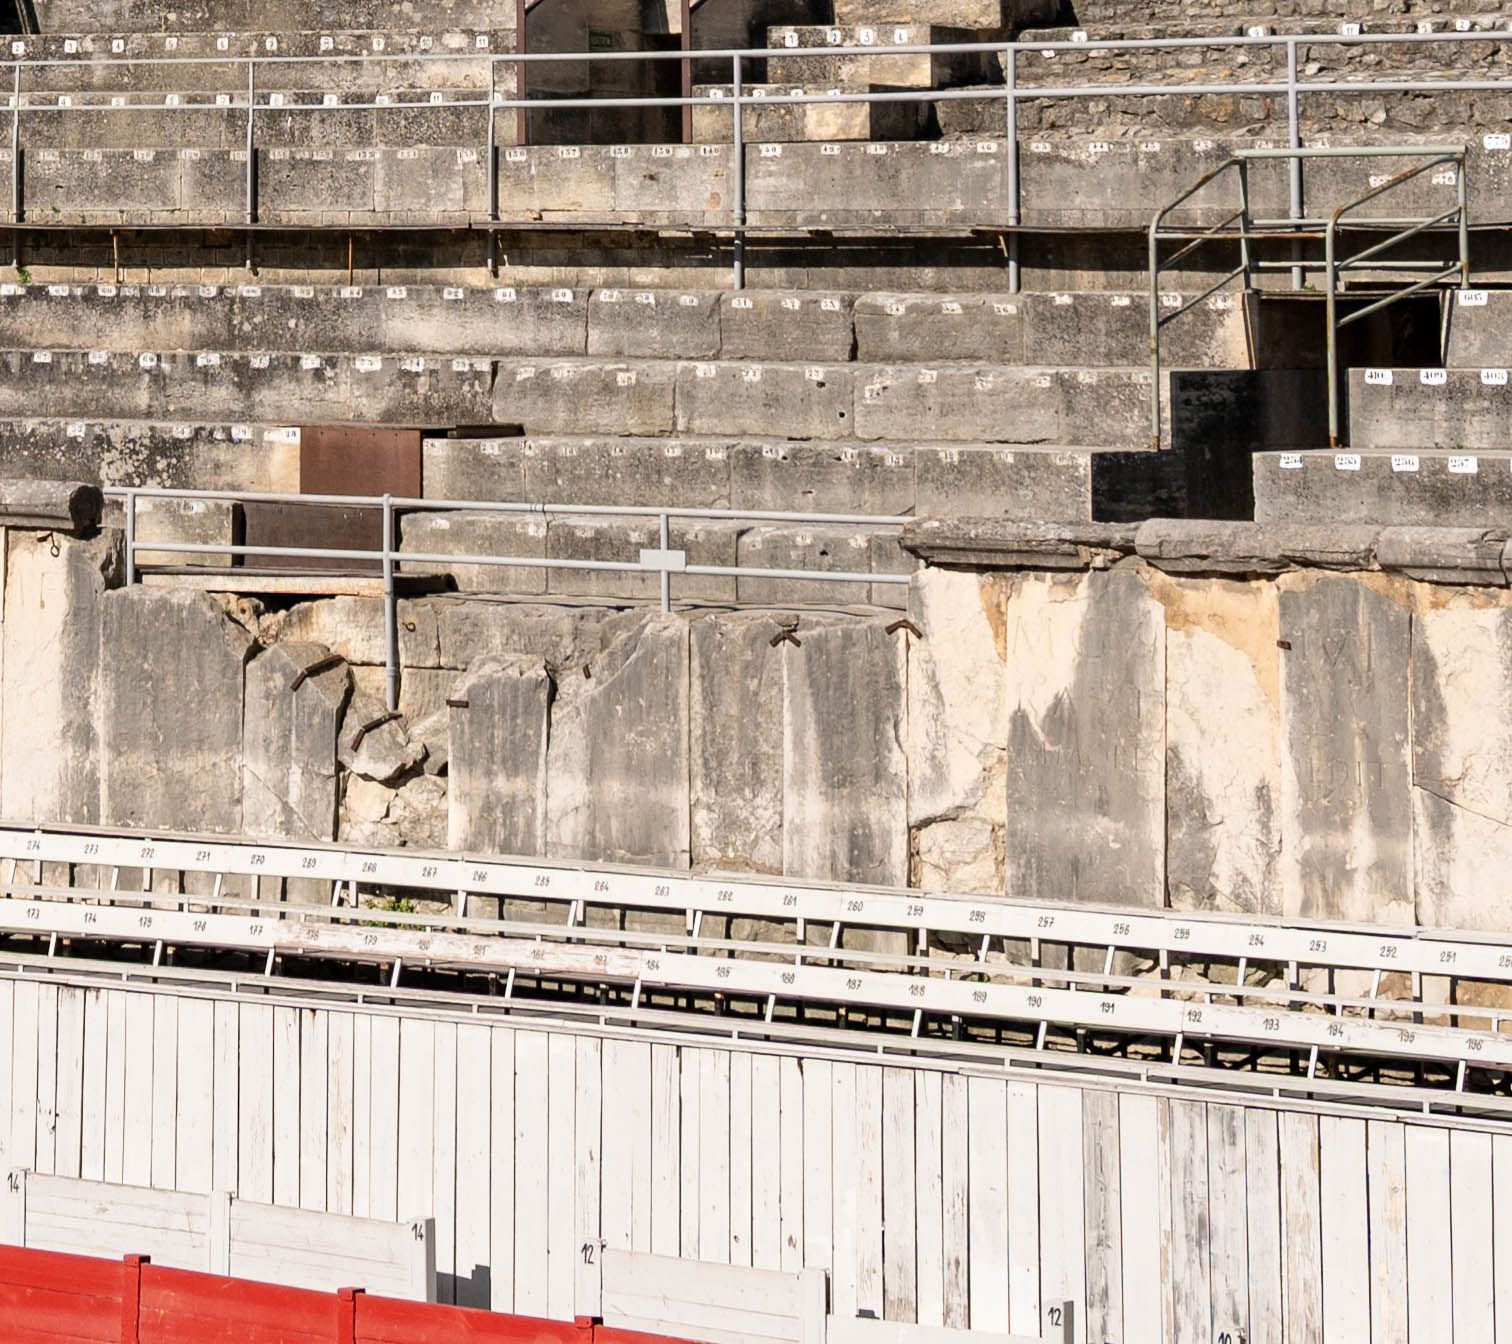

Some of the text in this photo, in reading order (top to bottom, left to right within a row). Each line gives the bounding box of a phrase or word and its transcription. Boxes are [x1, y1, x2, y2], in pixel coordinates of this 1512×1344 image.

[789, 35, 793, 43] 1
[830, 33, 836, 44] 2
[864, 32, 870, 42] 3
[26, 908, 39, 919] 173
[85, 913, 96, 923] 174
[1038, 917, 1054, 928] 257
[1113, 924, 1130, 935] 256
[1174, 928, 1190, 939] 255
[1249, 934, 1264, 946] 254
[1310, 940, 1327, 952] 253
[1380, 946, 1397, 958] 252
[1440, 951, 1456, 962] 251
[646, 960, 659, 970] 184
[846, 978, 862, 990] 187
[909, 984, 925, 996] 188
[973, 991, 987, 1003] 189
[1027, 996, 1042, 1008] 190
[1100, 1002, 1115, 1014] 191
[1187, 1010, 1202, 1022] 192
[1263, 1018, 1279, 1030] 193
[1328, 1022, 1346, 1037] 194
[1466, 1038, 1483, 1050] 196
[8, 1172, 19, 1192] 14
[412, 1224, 423, 1240] 14
[582, 1244, 593, 1264] 12
[1048, 1307, 1061, 1326] 12
